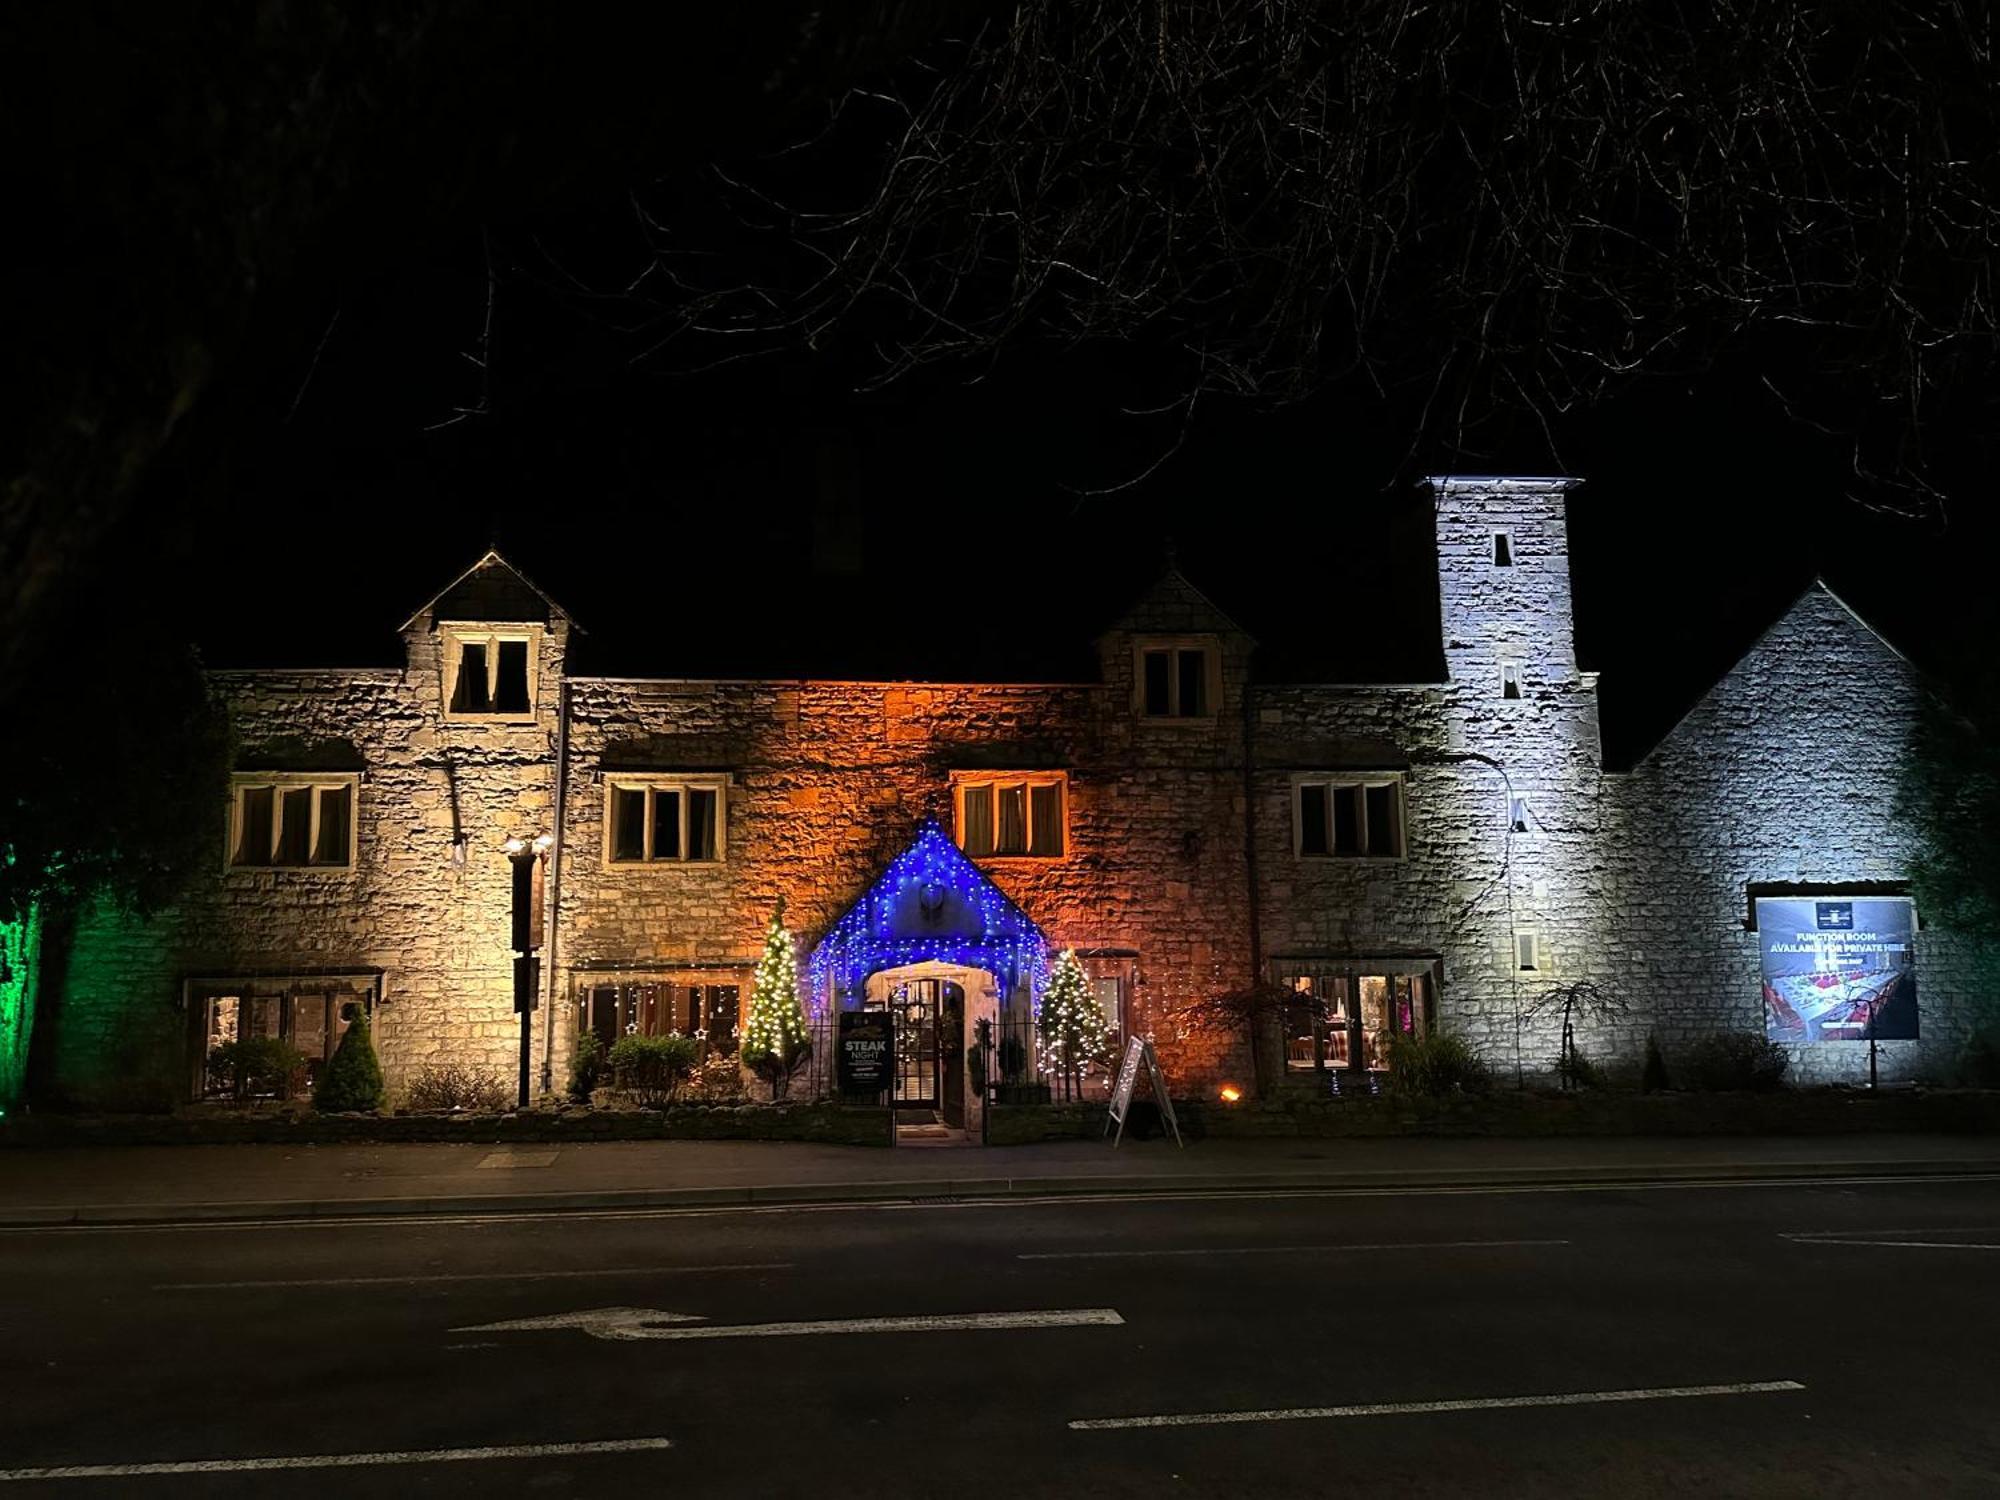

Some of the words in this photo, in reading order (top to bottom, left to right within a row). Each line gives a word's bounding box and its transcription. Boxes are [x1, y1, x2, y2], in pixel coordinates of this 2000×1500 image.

[1797, 933, 1844, 941] FUNCTION
[1846, 933, 1876, 941] ROOM
[1771, 944, 1822, 952] AVAILABLE
[1823, 944, 1842, 952] FOR
[1844, 944, 1882, 952] PRIVATE
[845, 1041, 886, 1051] STEAK
[851, 1051, 879, 1059] NIGHT
